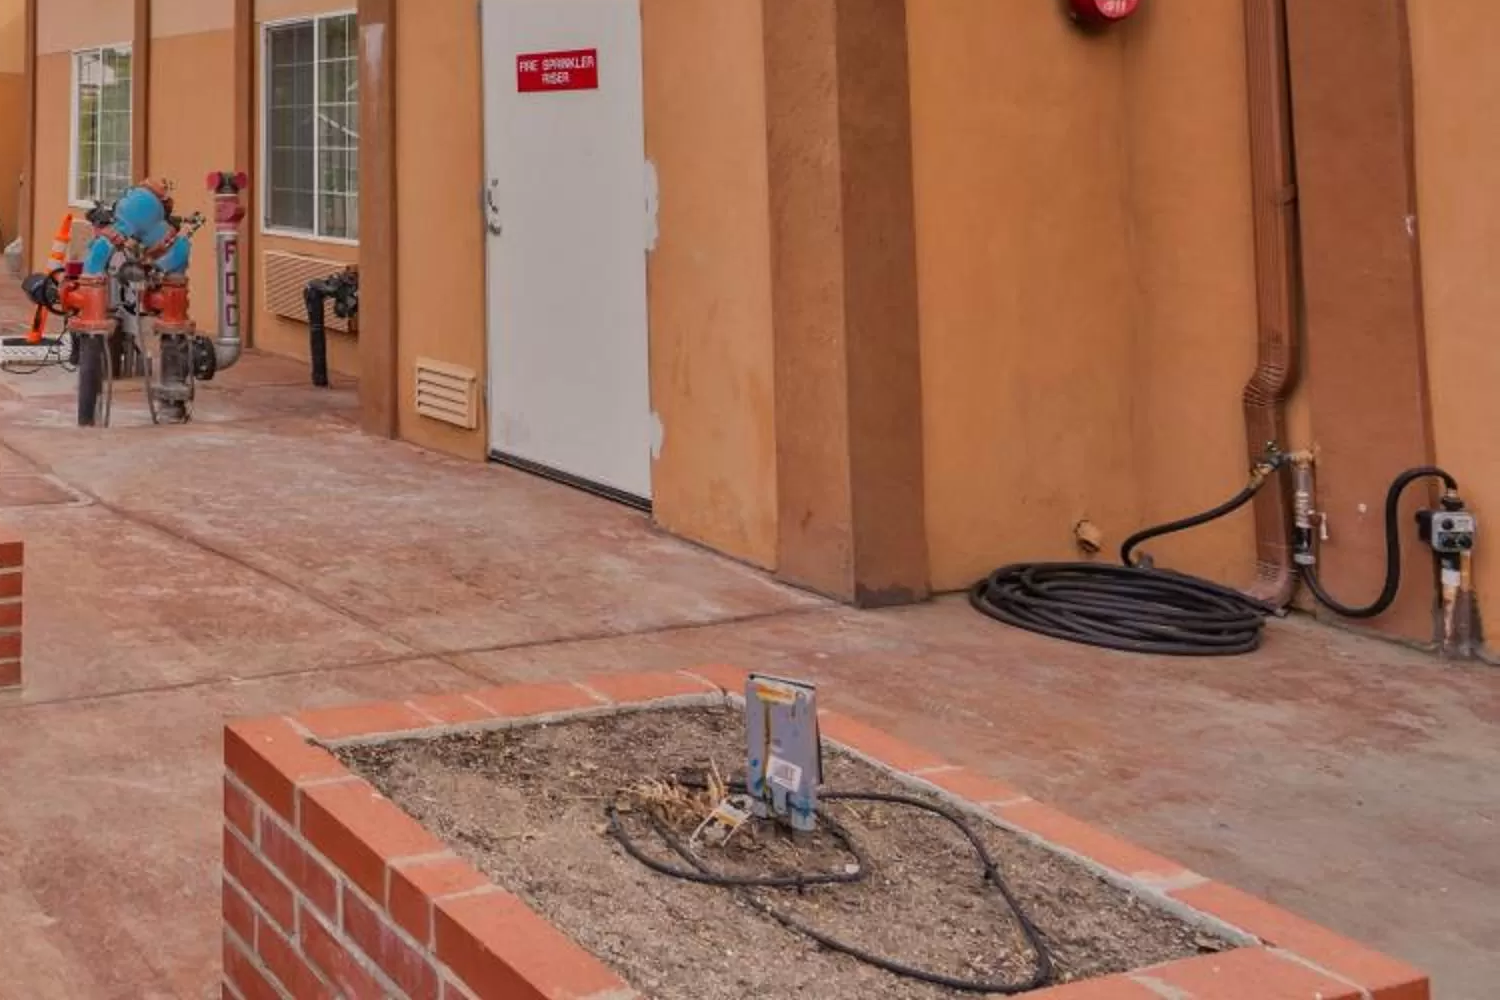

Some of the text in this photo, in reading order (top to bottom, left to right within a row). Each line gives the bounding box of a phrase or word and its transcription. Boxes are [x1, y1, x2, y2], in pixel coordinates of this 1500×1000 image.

[519, 55, 595, 73] FIRE SPRINKLER
[541, 71, 570, 86] RISER
